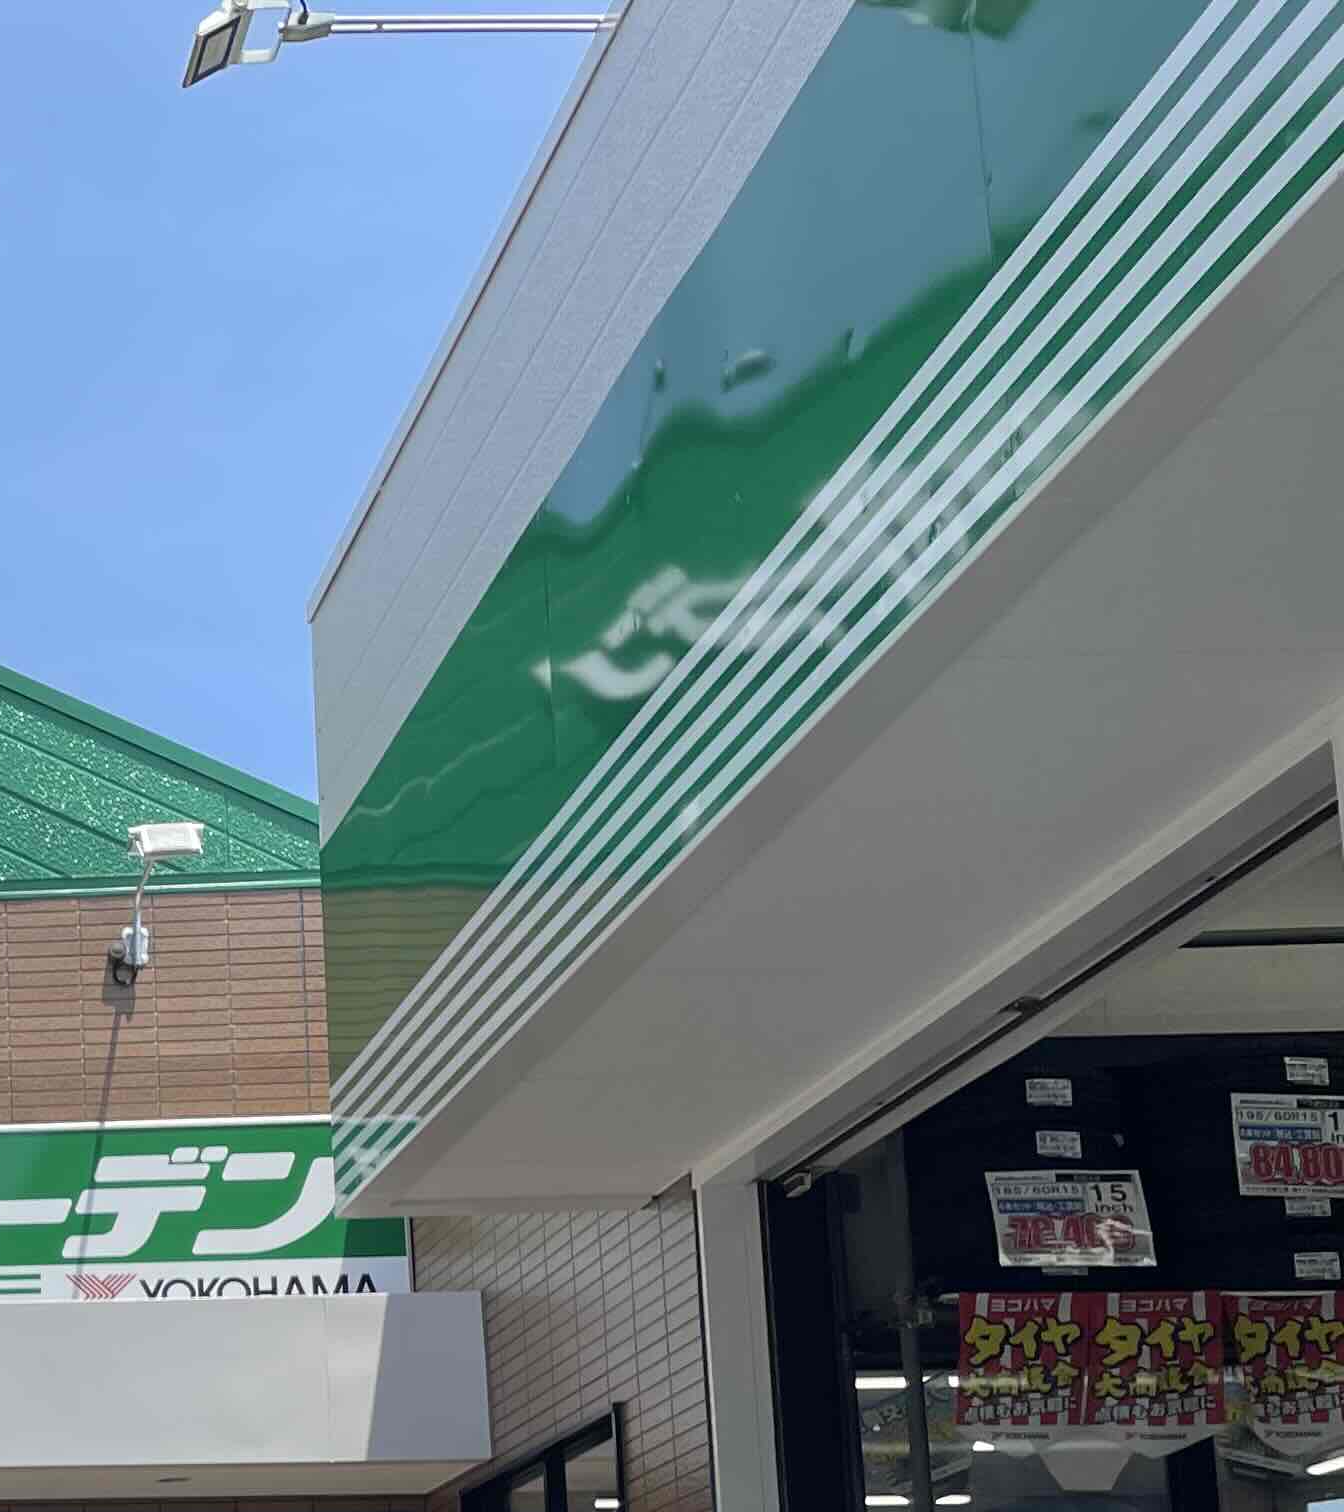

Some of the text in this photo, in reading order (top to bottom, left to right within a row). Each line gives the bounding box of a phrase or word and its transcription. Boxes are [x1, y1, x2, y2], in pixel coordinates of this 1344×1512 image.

[139, 1273, 378, 1298] YOKOHAMA
[964, 1316, 1081, 1366] タイヤ
[1095, 1316, 1215, 1366] タイヤ
[1234, 1314, 1344, 1364] タイヤ
